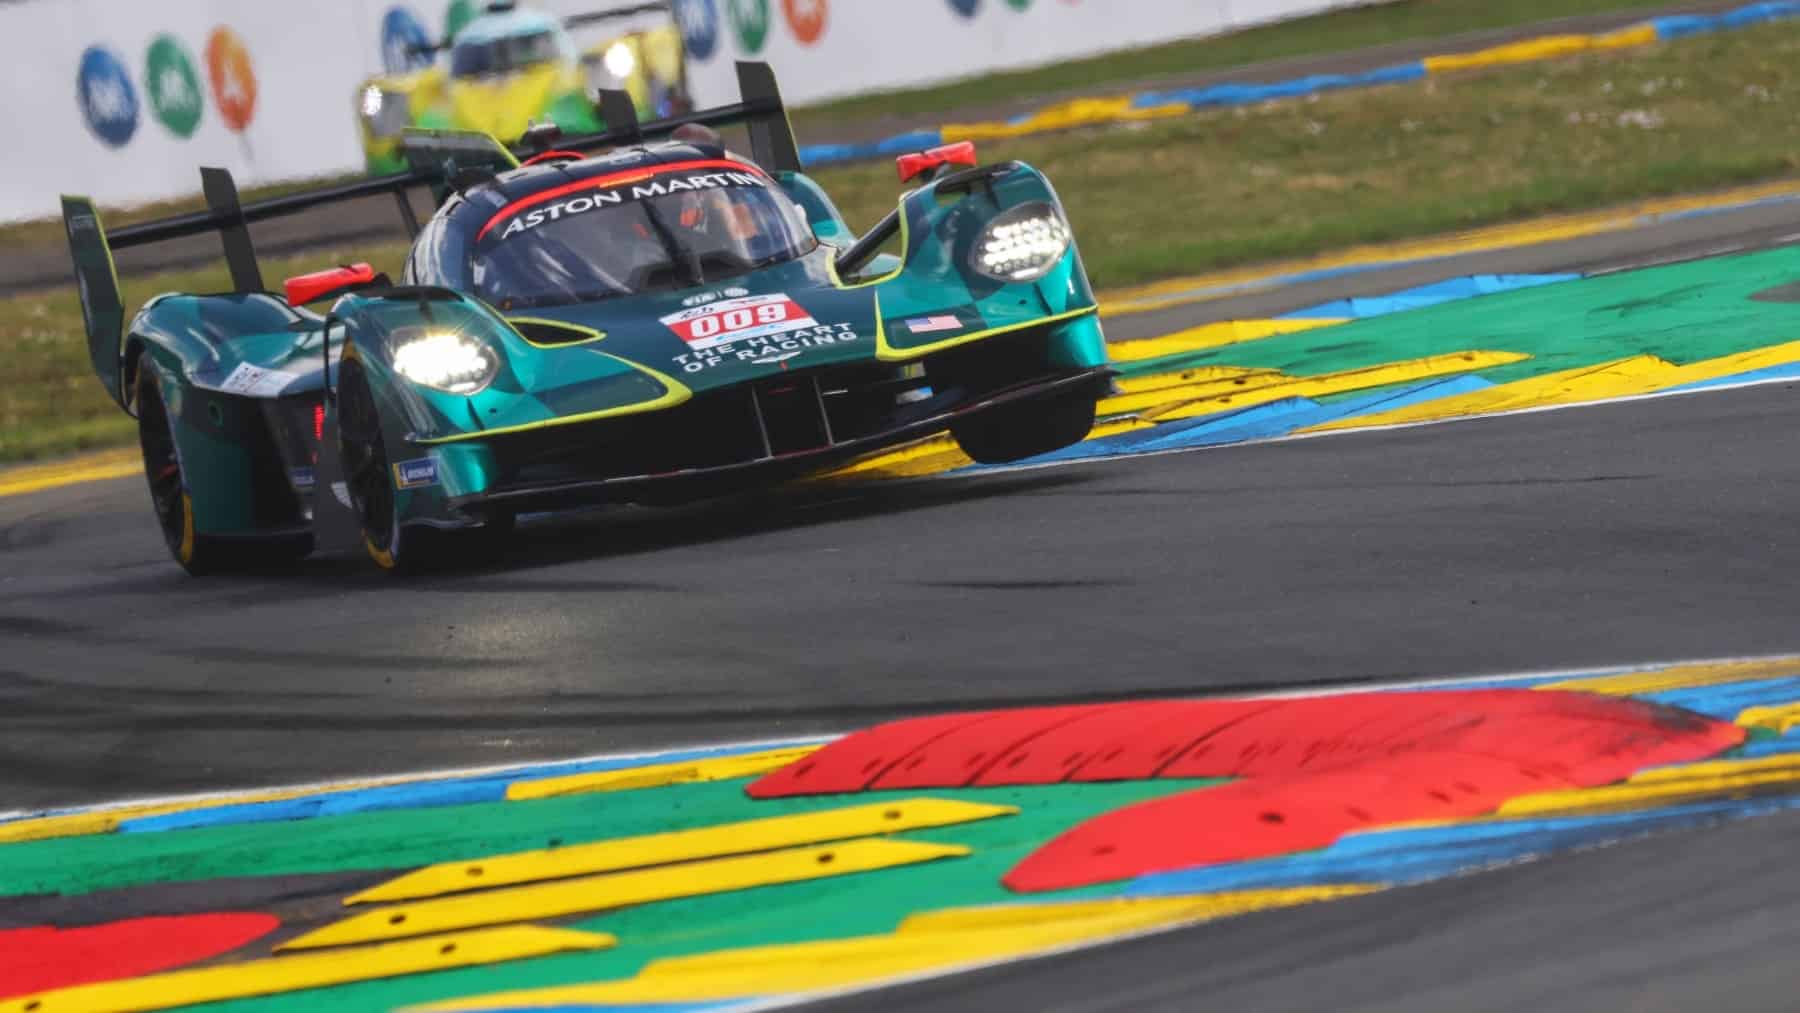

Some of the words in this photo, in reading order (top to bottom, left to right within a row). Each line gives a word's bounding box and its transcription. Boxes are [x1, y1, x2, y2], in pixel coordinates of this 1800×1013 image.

[502, 191, 622, 240] ASTON
[633, 172, 765, 200] MARTIN
[690, 303, 787, 338] 009
[672, 343, 736, 365] THE
[746, 322, 852, 347] HEART
[683, 355, 723, 374] OF
[736, 331, 857, 361] RACING
